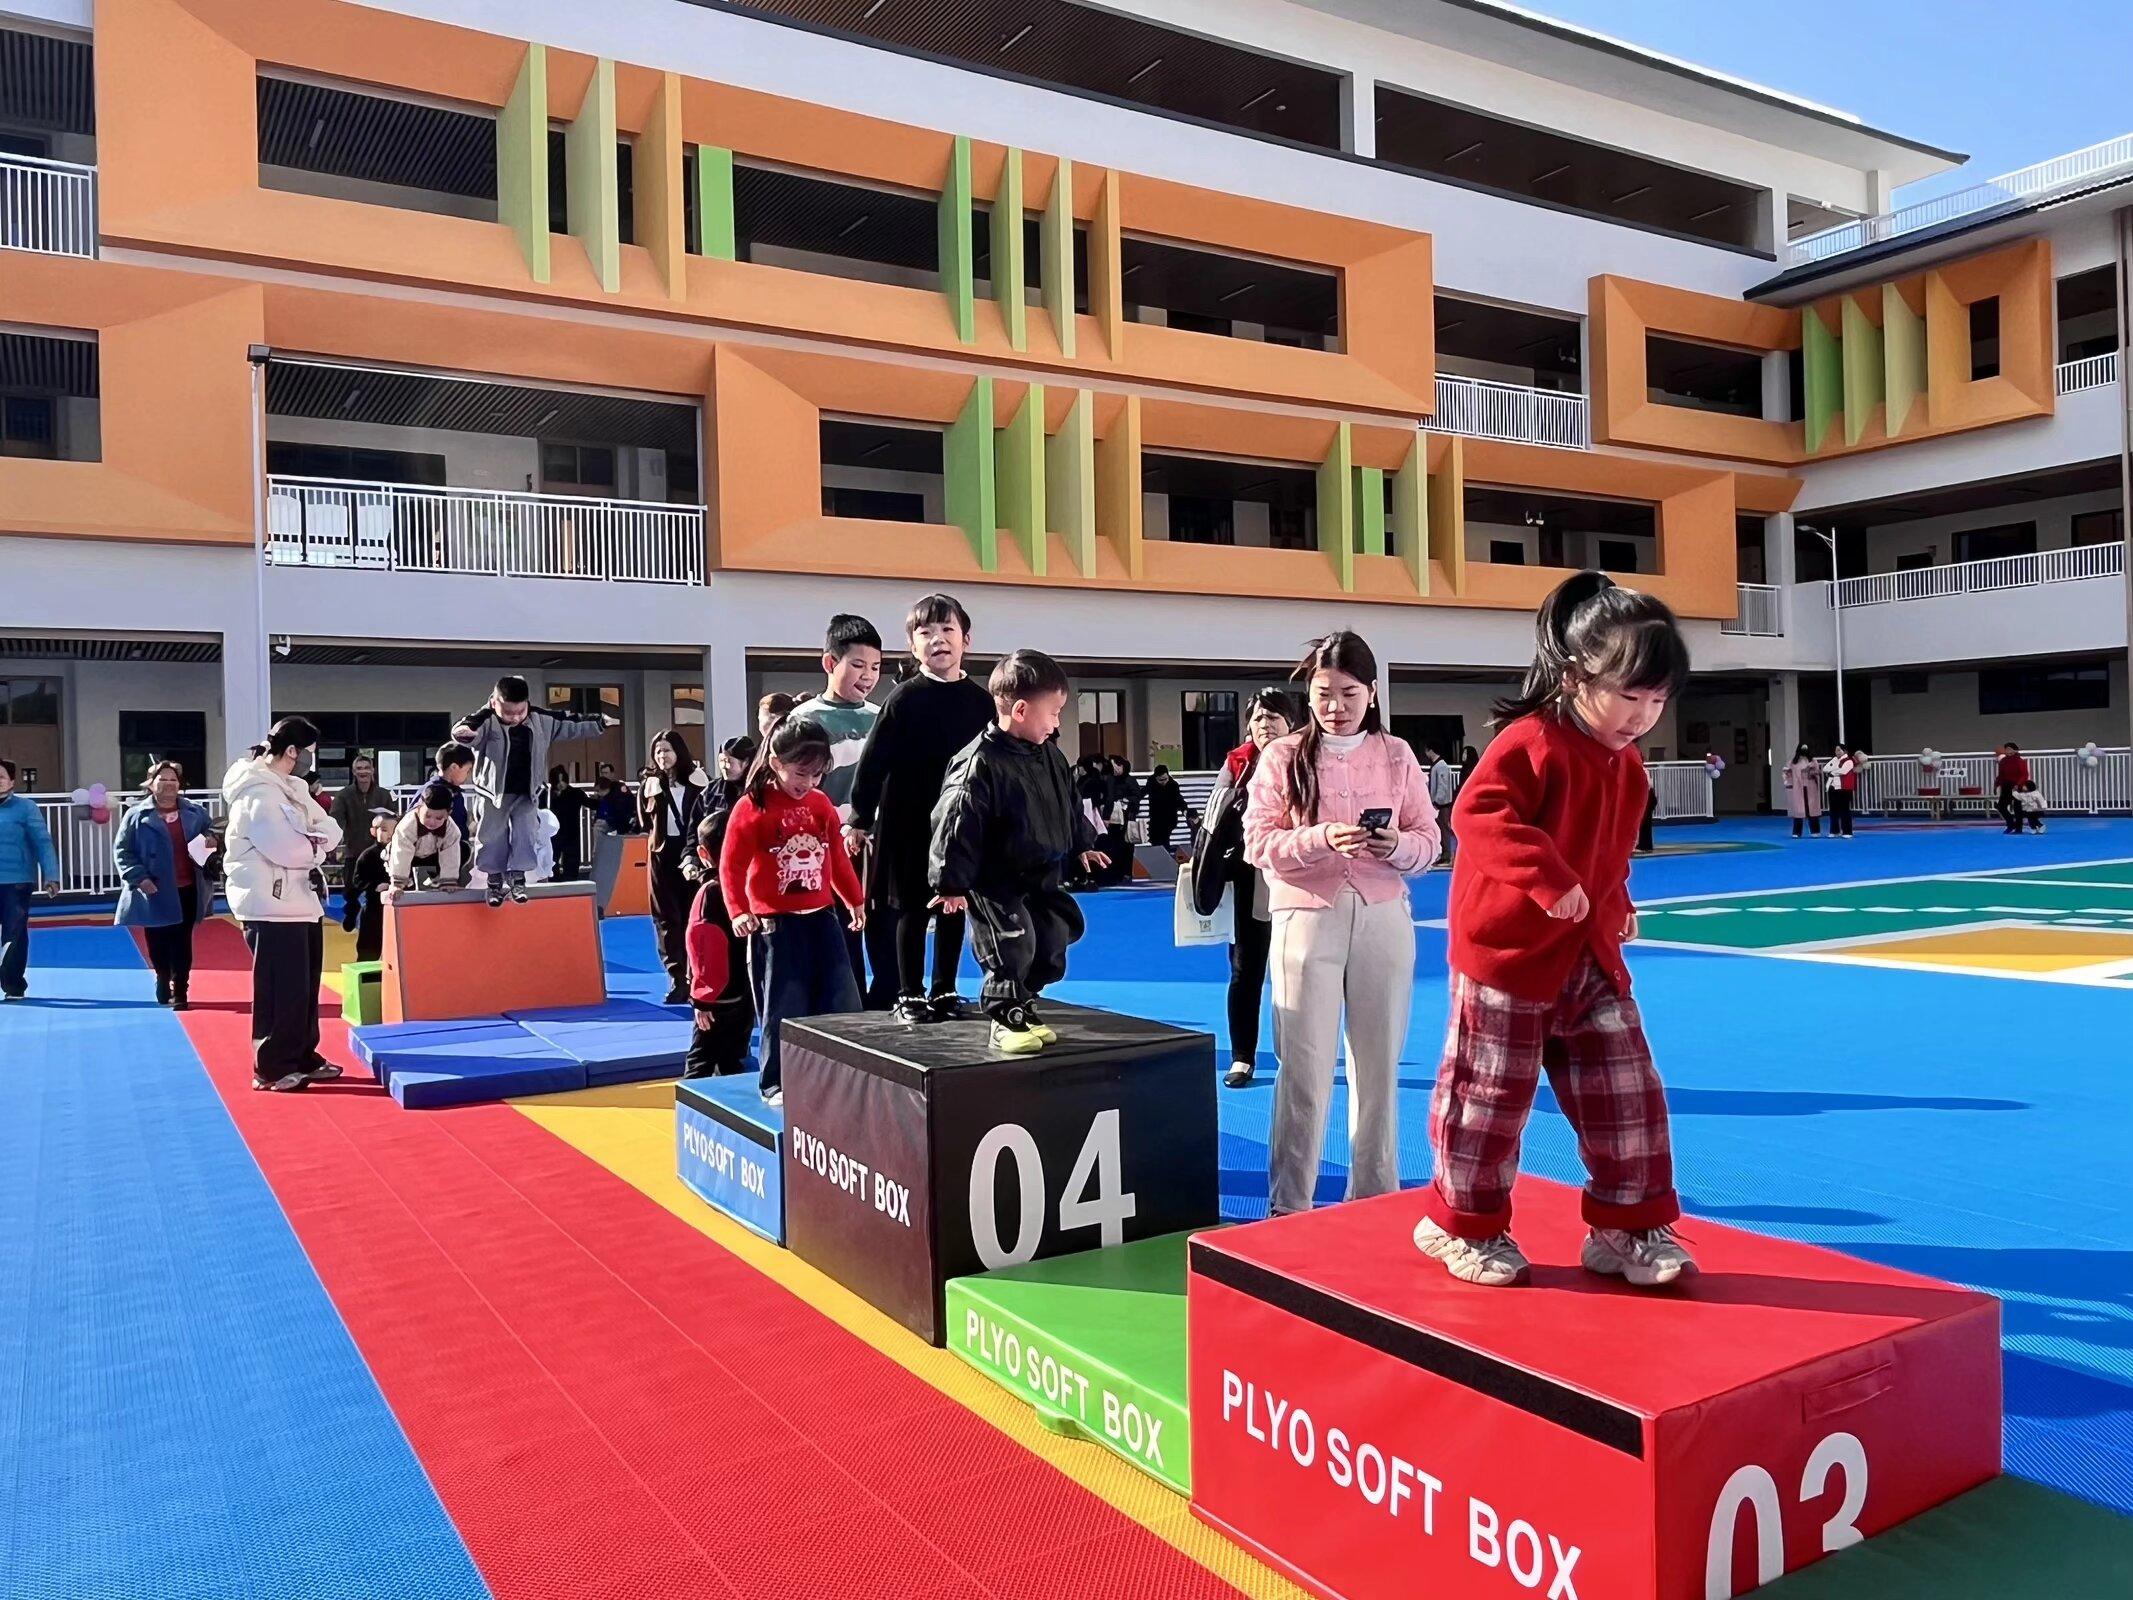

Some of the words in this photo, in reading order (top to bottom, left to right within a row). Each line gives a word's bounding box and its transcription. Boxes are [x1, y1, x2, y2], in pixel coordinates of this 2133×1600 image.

[683, 1122, 709, 1164] PLYO
[708, 1137, 735, 1180] SOFT
[741, 1156, 766, 1199] BOX
[792, 1126, 827, 1177] PLYO
[828, 1147, 869, 1202] SOFT
[874, 1171, 911, 1228] BOX
[968, 1109, 1136, 1270] 04
[966, 1308, 1021, 1377] PLYO
[1026, 1345, 1089, 1420] SOFT
[1103, 1390, 1163, 1468] BOX
[1222, 1369, 1316, 1468] PLYO
[1326, 1426, 1443, 1536] SOFT
[1468, 1495, 1582, 1600] BOX
